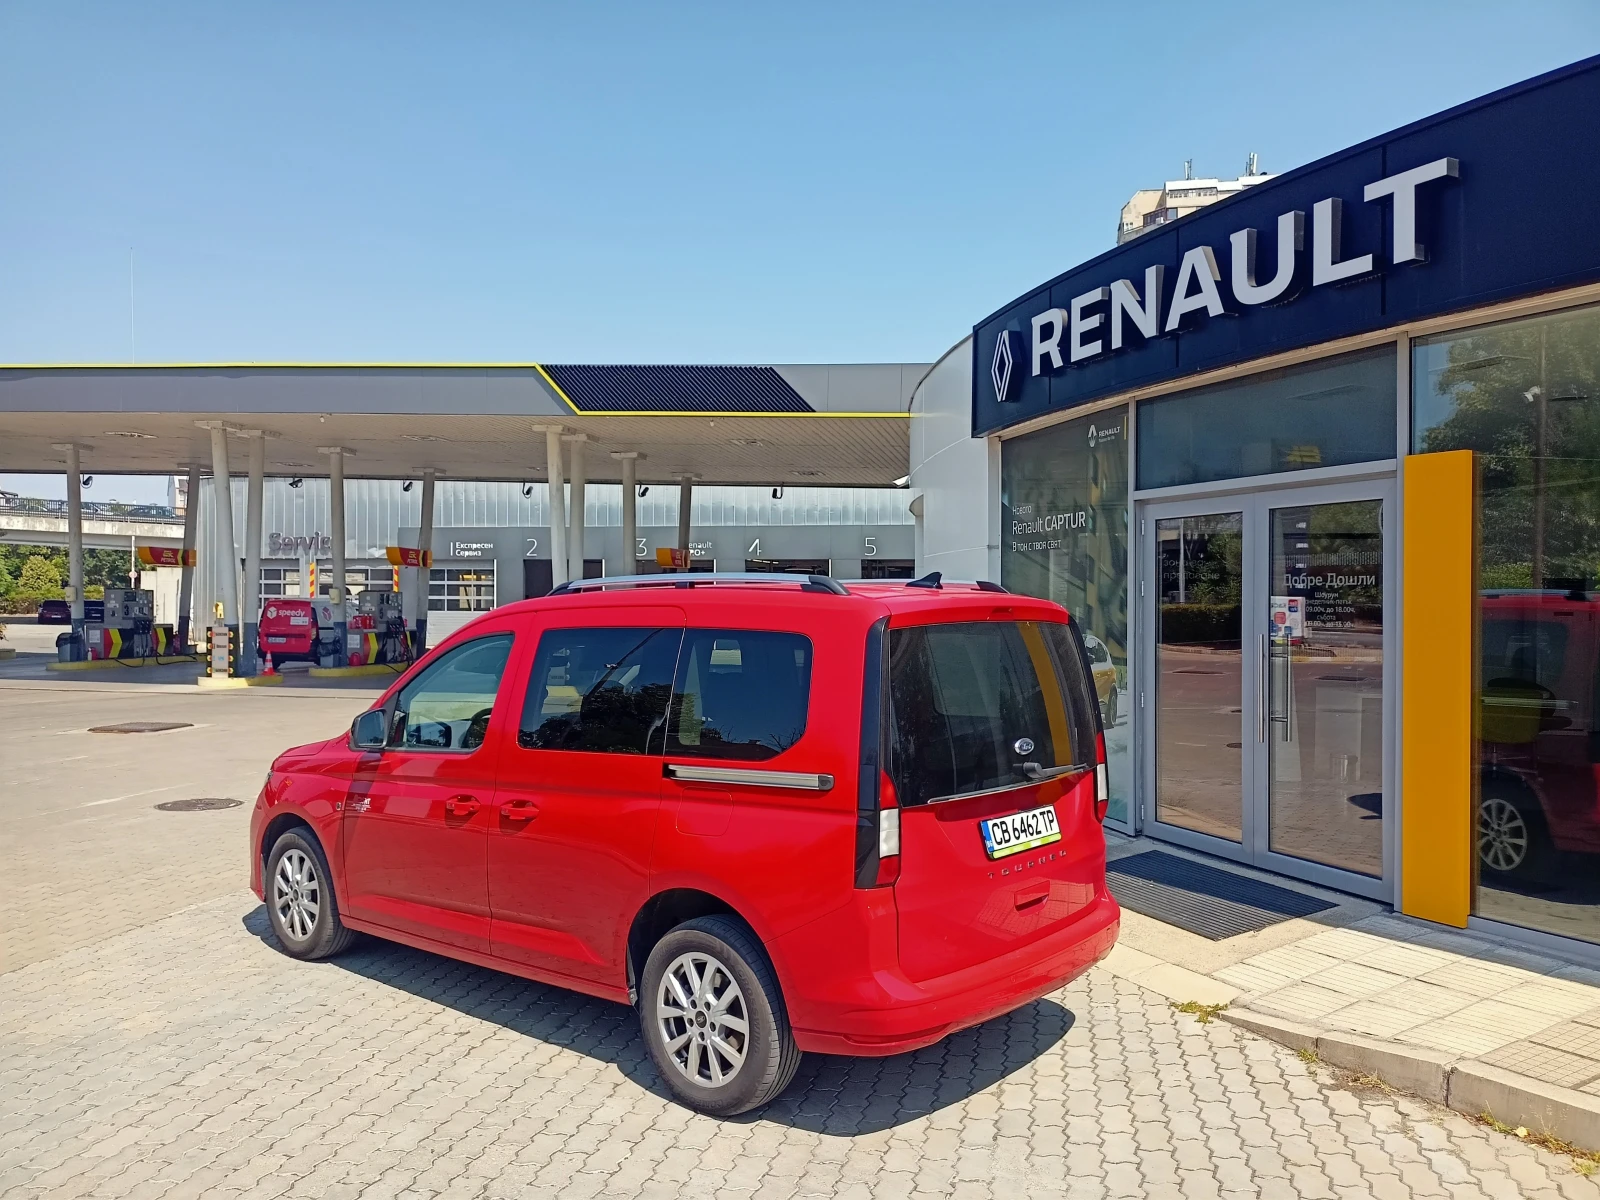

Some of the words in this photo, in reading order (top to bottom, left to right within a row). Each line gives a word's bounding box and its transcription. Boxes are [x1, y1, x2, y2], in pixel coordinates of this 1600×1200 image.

[1030, 156, 1459, 378] RENAULT
[1012, 516, 1044, 536] Renault
[1044, 511, 1086, 532] CAPTUR
[268, 531, 332, 552] Servic
[455, 542, 494, 550] Експресен
[526, 538, 538, 557] 2
[635, 538, 648, 557] 3
[748, 538, 762, 556] 4
[864, 537, 877, 556] 5
[455, 549, 482, 557] Сервиз
[1283, 573, 1323, 589] Добре
[1325, 573, 1376, 589] Дошли
[124, 604, 130, 616] 3
[278, 608, 305, 617] speedy
[991, 820, 1012, 846] CB
[1012, 813, 1041, 840] 6462
[1039, 809, 1055, 833] TP
